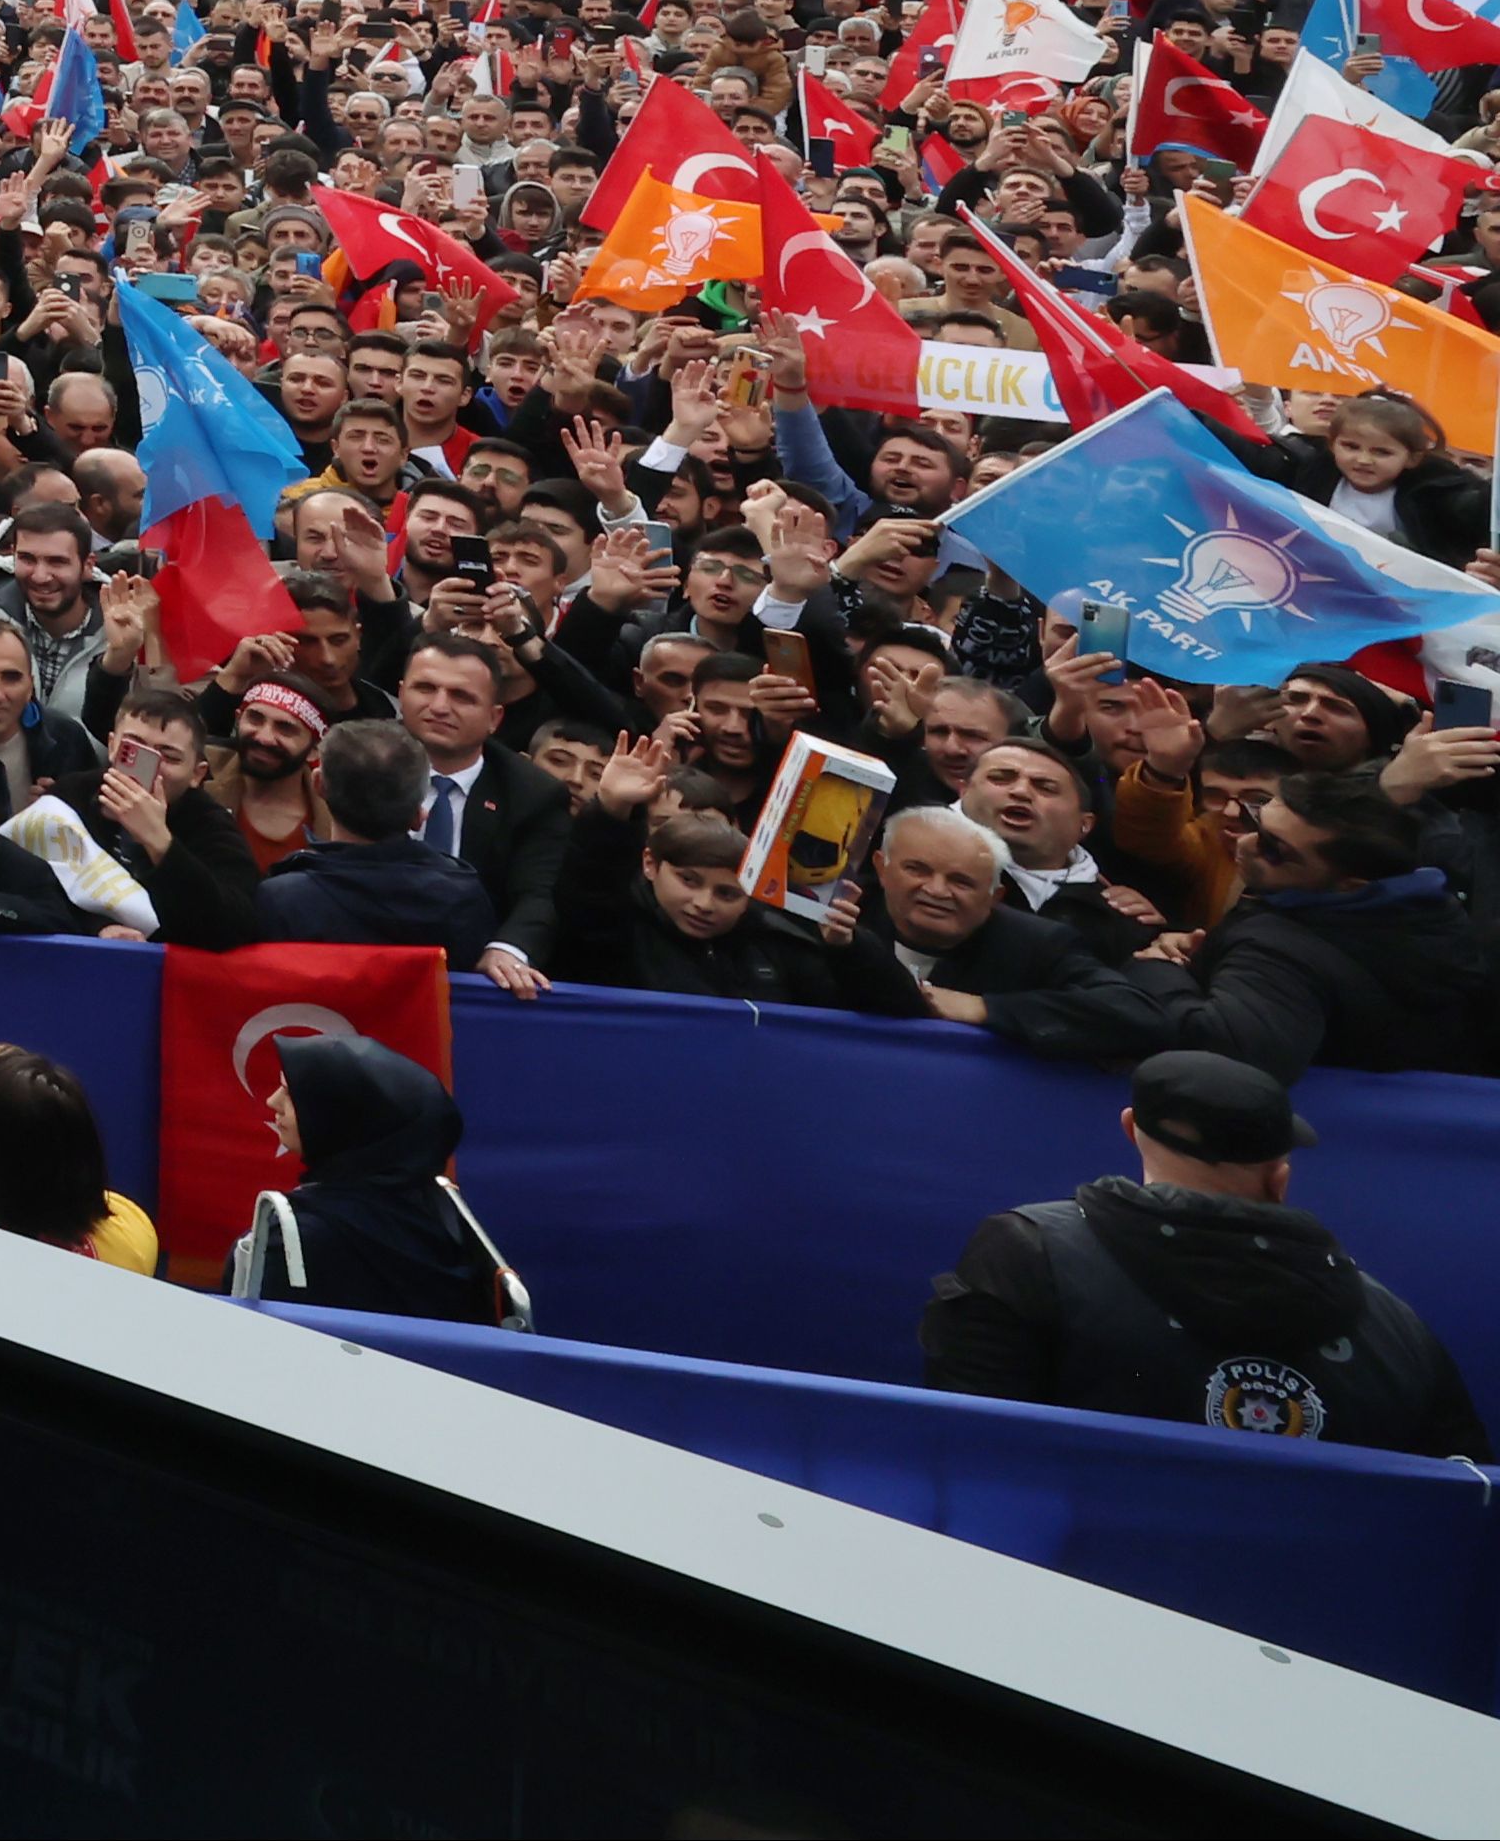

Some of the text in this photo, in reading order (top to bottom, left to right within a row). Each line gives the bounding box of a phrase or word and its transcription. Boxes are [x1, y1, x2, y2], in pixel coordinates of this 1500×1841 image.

[1088, 577, 1221, 662] AK PARTİ
[1230, 1361, 1301, 1393] POLİS
